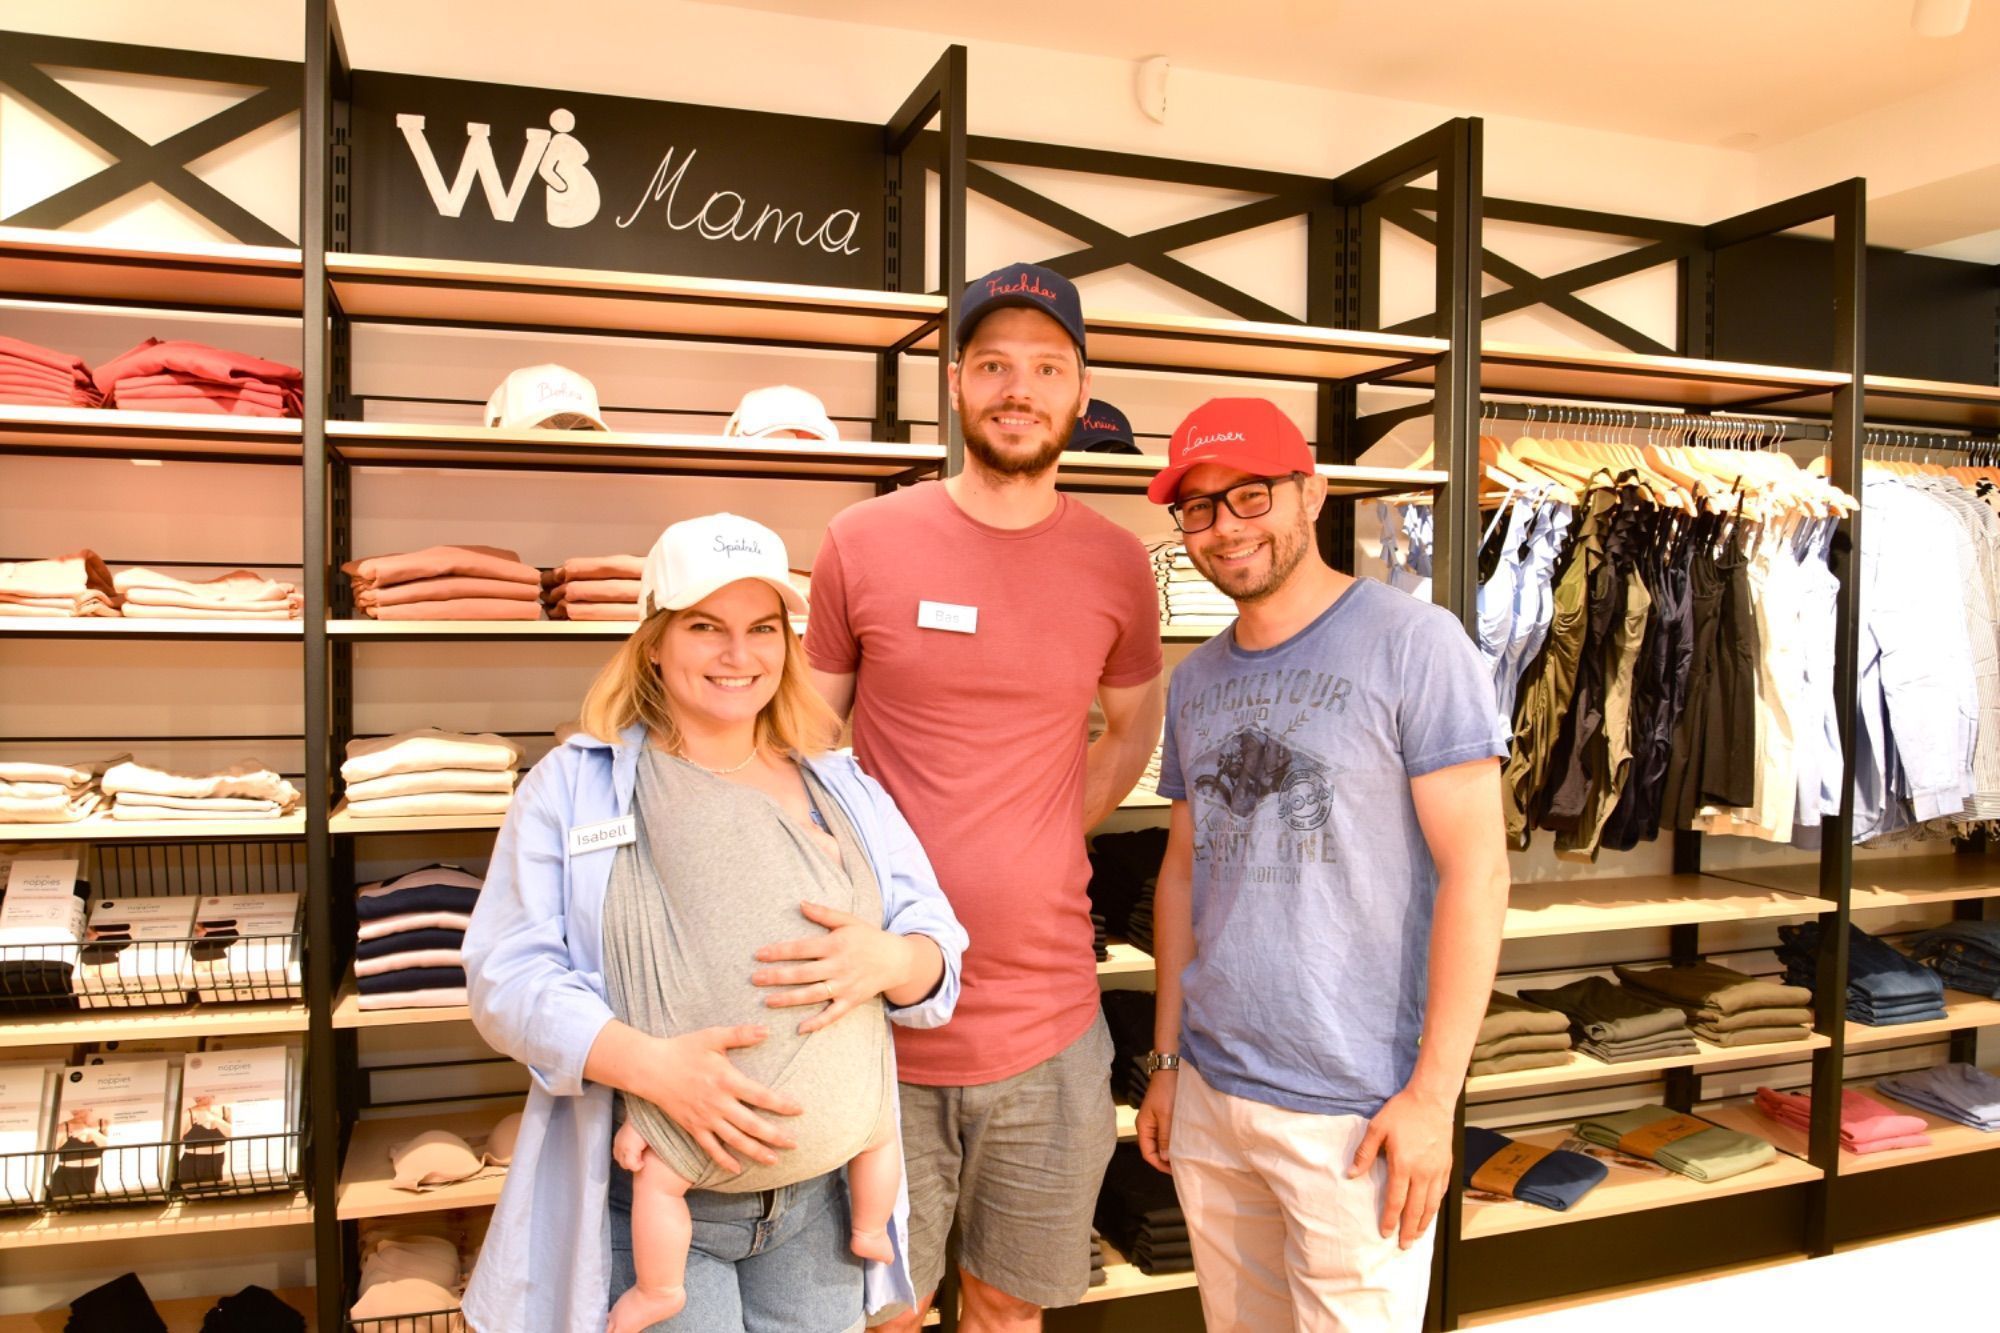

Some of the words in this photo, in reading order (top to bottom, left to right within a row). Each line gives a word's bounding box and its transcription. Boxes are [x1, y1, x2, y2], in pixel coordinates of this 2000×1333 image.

[615, 145, 861, 255] Mama
[935, 609, 961, 624] Bas
[576, 823, 628, 846] Isabell
[23, 878, 61, 888] noppies
